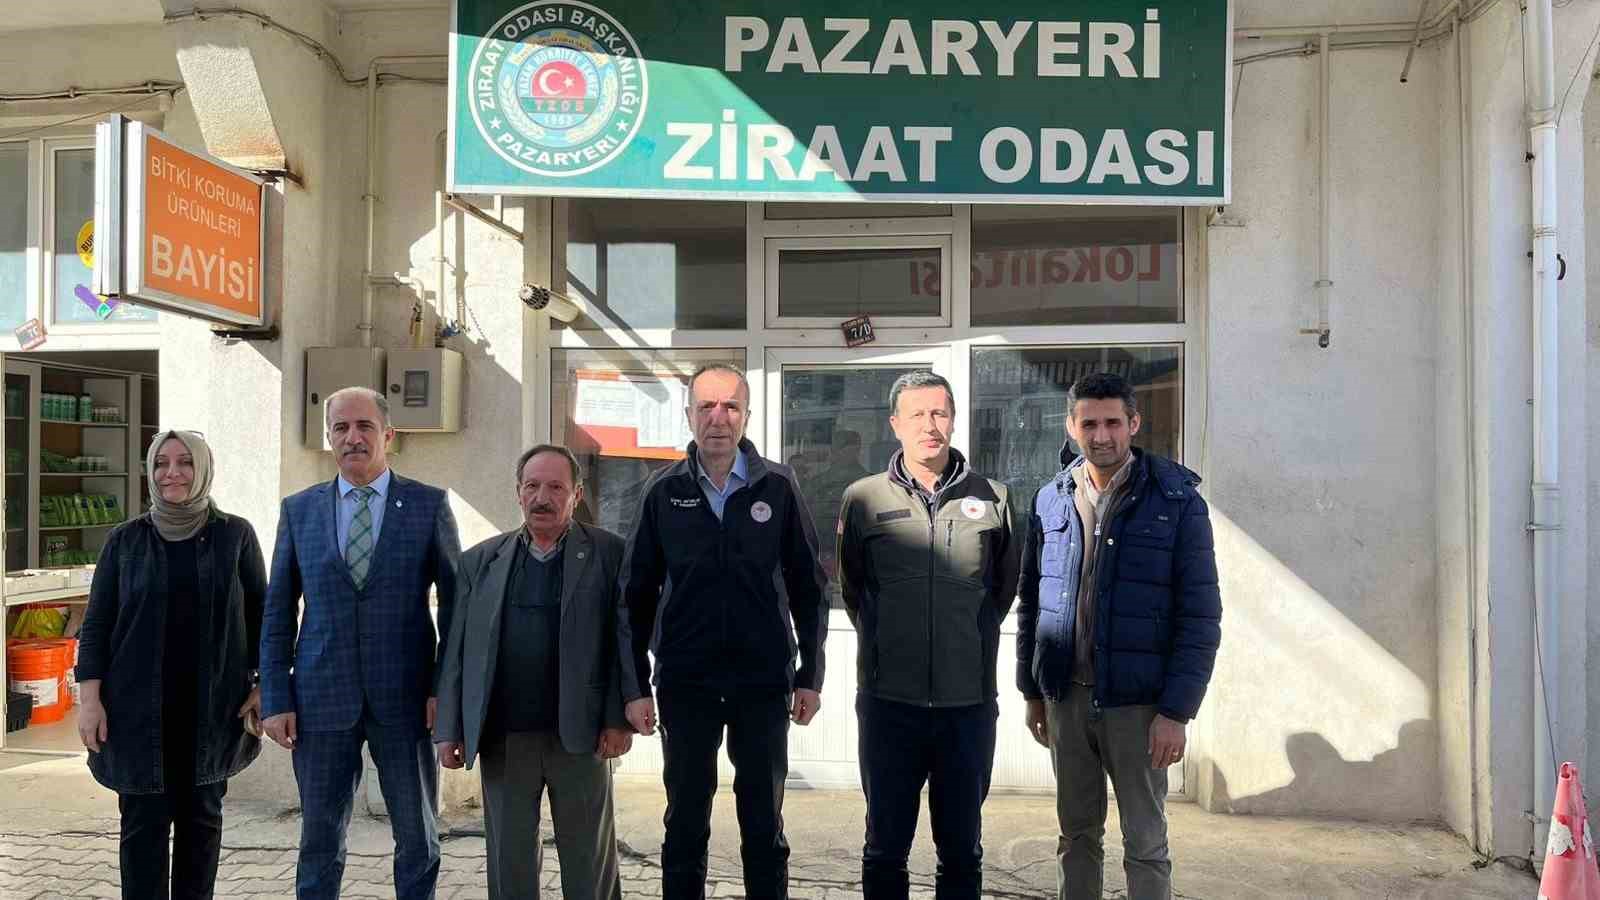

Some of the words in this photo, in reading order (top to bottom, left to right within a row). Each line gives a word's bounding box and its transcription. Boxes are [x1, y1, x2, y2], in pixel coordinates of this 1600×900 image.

[503, 8, 563, 39] ODASI
[570, 10, 640, 114] BAŞKANLIĞI
[724, 8, 1161, 78] PAZARYERİ
[663, 109, 952, 182] ZİRAAT
[979, 126, 1215, 186] ODASI
[151, 155, 191, 188] BİTKİ
[195, 175, 256, 217] KORUMA
[167, 192, 241, 238] ÜRÜNLERİ
[151, 234, 254, 302] BAYİSİ
